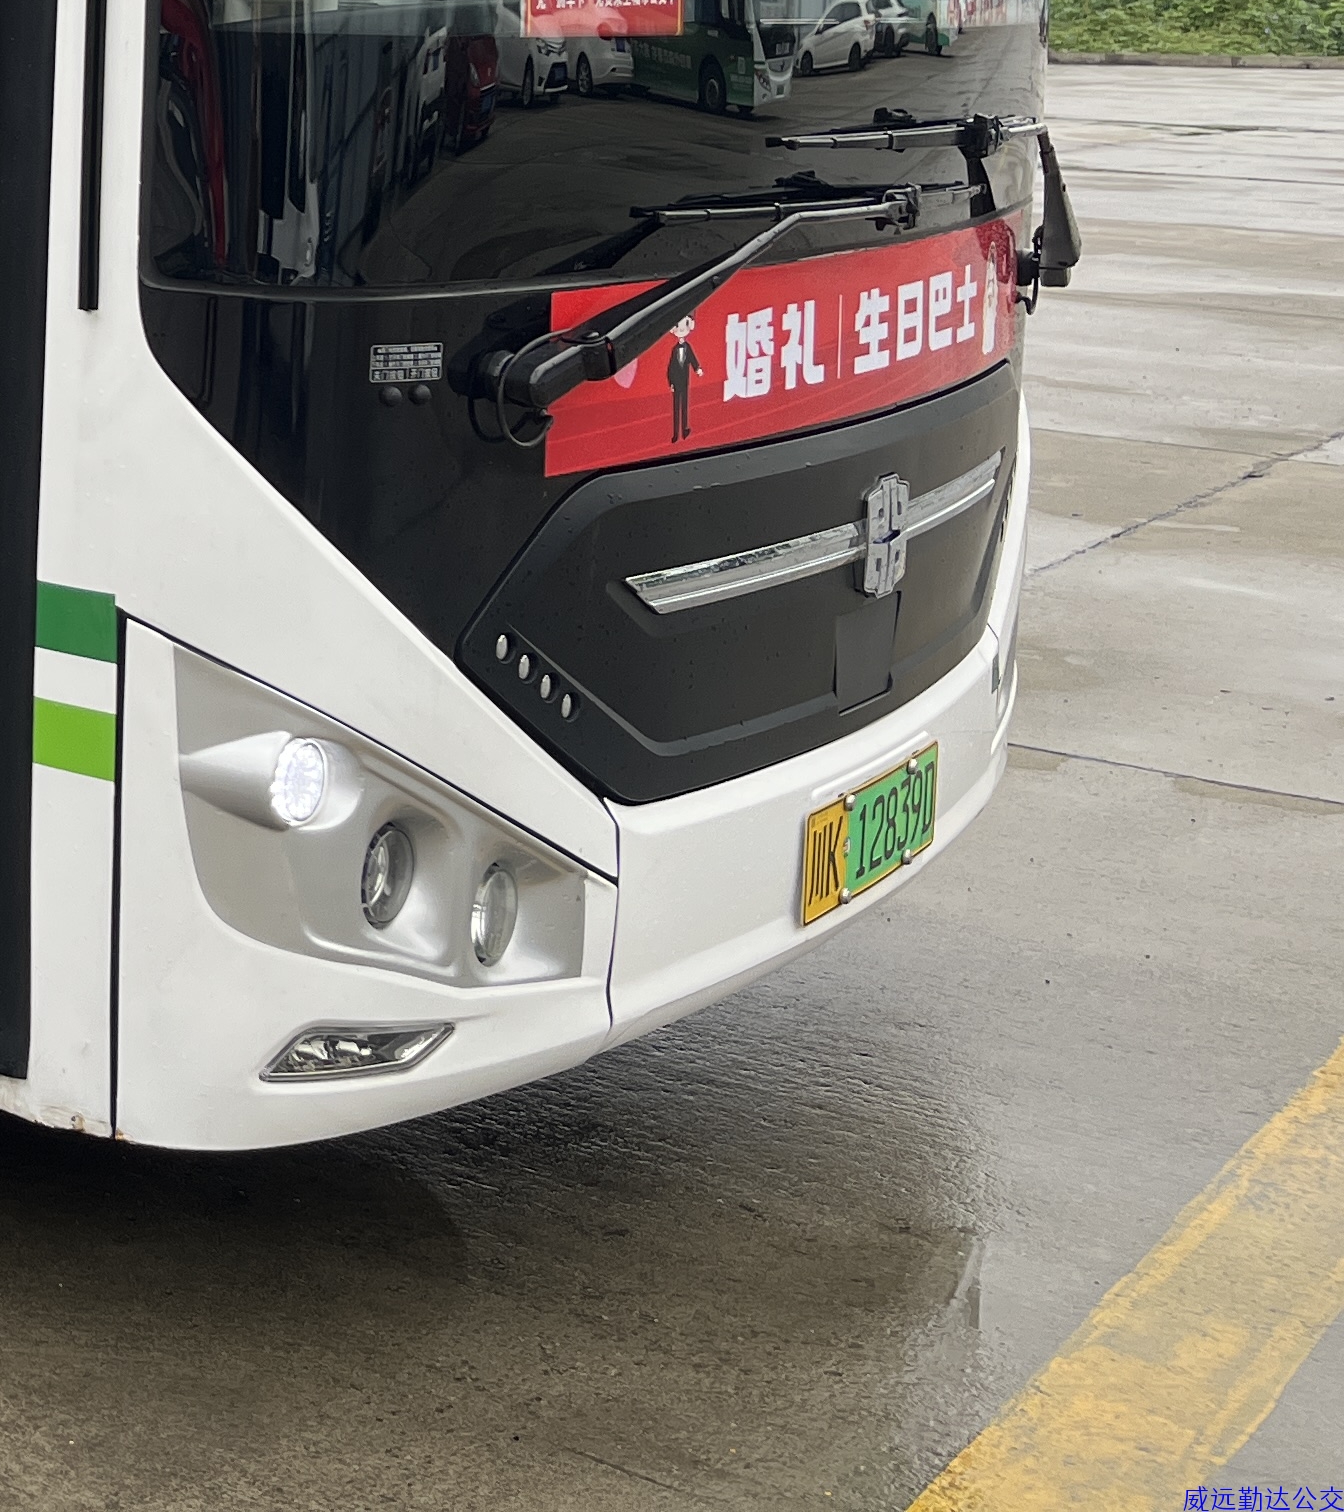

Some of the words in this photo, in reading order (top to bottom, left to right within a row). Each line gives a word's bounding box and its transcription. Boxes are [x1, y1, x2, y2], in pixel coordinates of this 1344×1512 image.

[723, 299, 825, 403] 婚礼
[854, 264, 978, 375] 生日巴士
